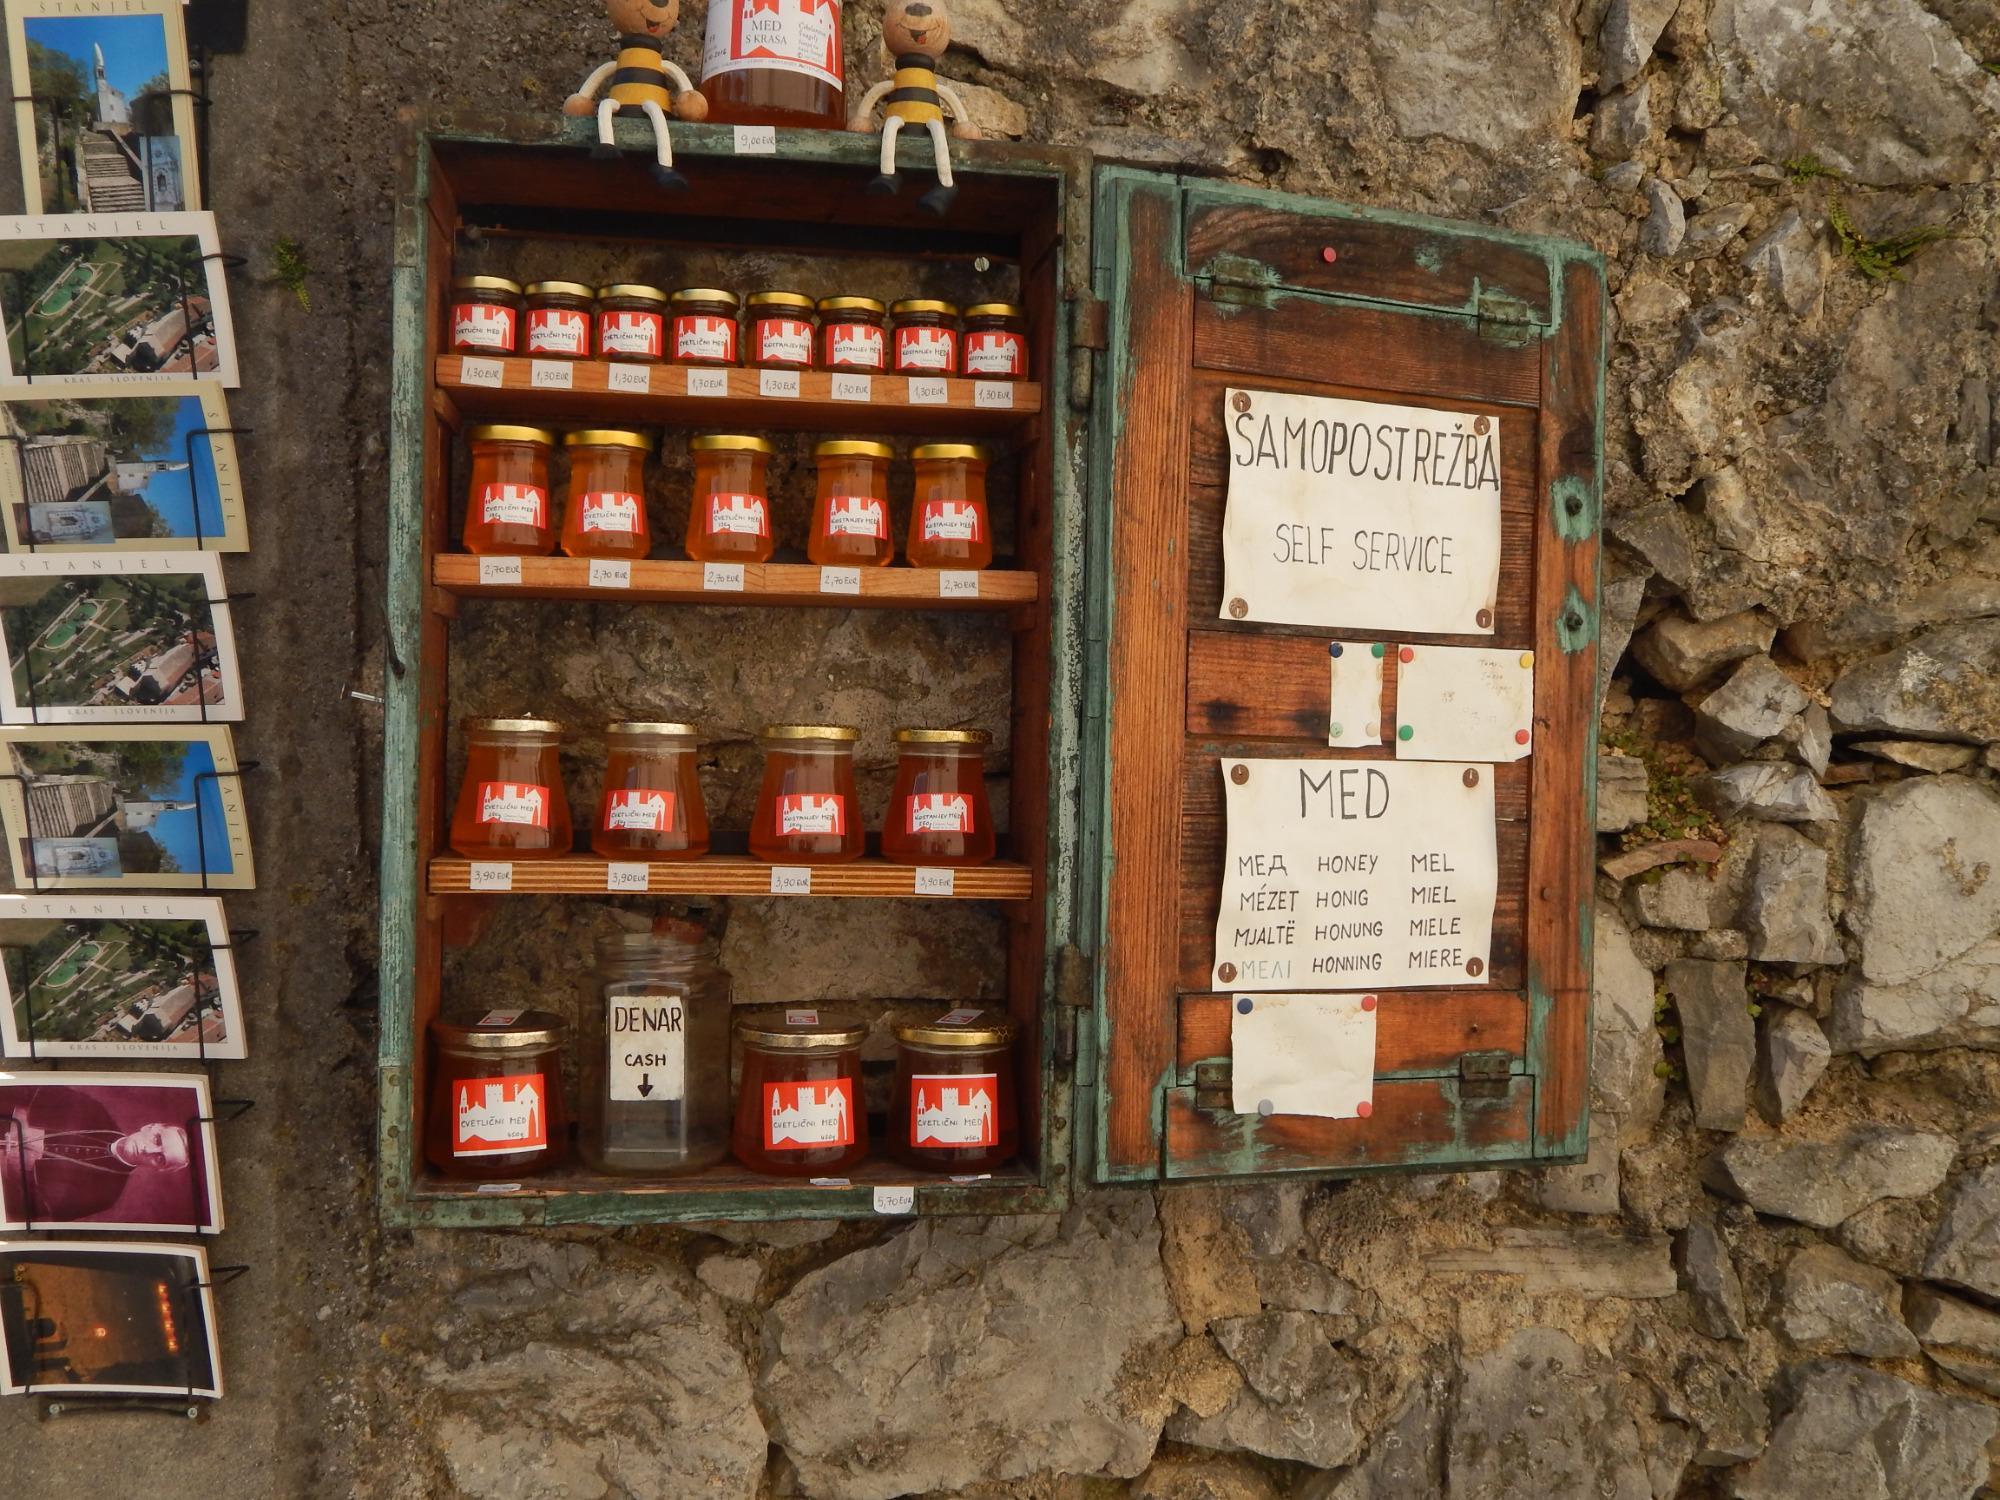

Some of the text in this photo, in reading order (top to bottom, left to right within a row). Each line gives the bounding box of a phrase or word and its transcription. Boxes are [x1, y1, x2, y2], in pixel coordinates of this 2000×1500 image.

[752, 19, 782, 32] MED
[746, 34, 751, 43] S
[753, 34, 787, 45] KRASA
[486, 328, 500, 336] MED
[635, 333, 649, 341] MED
[711, 339, 725, 347] MED
[934, 348, 948, 357] MED
[1000, 353, 1015, 363] MED
[1235, 412, 1500, 492] SAMOPOSTREŽBA
[619, 512, 631, 520] MED
[747, 515, 760, 523] MED
[866, 517, 880, 525] MED
[1272, 523, 1453, 575] SELF SERVICE
[1299, 767, 1390, 820] MED
[520, 804, 534, 812] MED
[643, 811, 656, 819] MED
[947, 812, 962, 820] MED
[1238, 854, 1288, 877] МЕД
[1317, 854, 1379, 875] HONEY
[1411, 852, 1455, 873] MEL
[1239, 883, 1300, 913] MÉZET
[1316, 888, 1369, 909] HONIG
[1411, 885, 1457, 905] MIEL
[1314, 920, 1384, 942] HONUNG
[1409, 917, 1462, 937] MIELE
[1233, 920, 1296, 948] MJALTË
[1312, 952, 1383, 974] HONNING
[1408, 948, 1463, 970] MIERE
[614, 1006, 682, 1033] DENAR
[624, 1053, 667, 1067] CASH
[460, 1115, 527, 1128] CVETLIČNI MED
[773, 1118, 838, 1130] CVETLIČNI MED
[917, 1117, 983, 1128] CVETLIČNI MED
